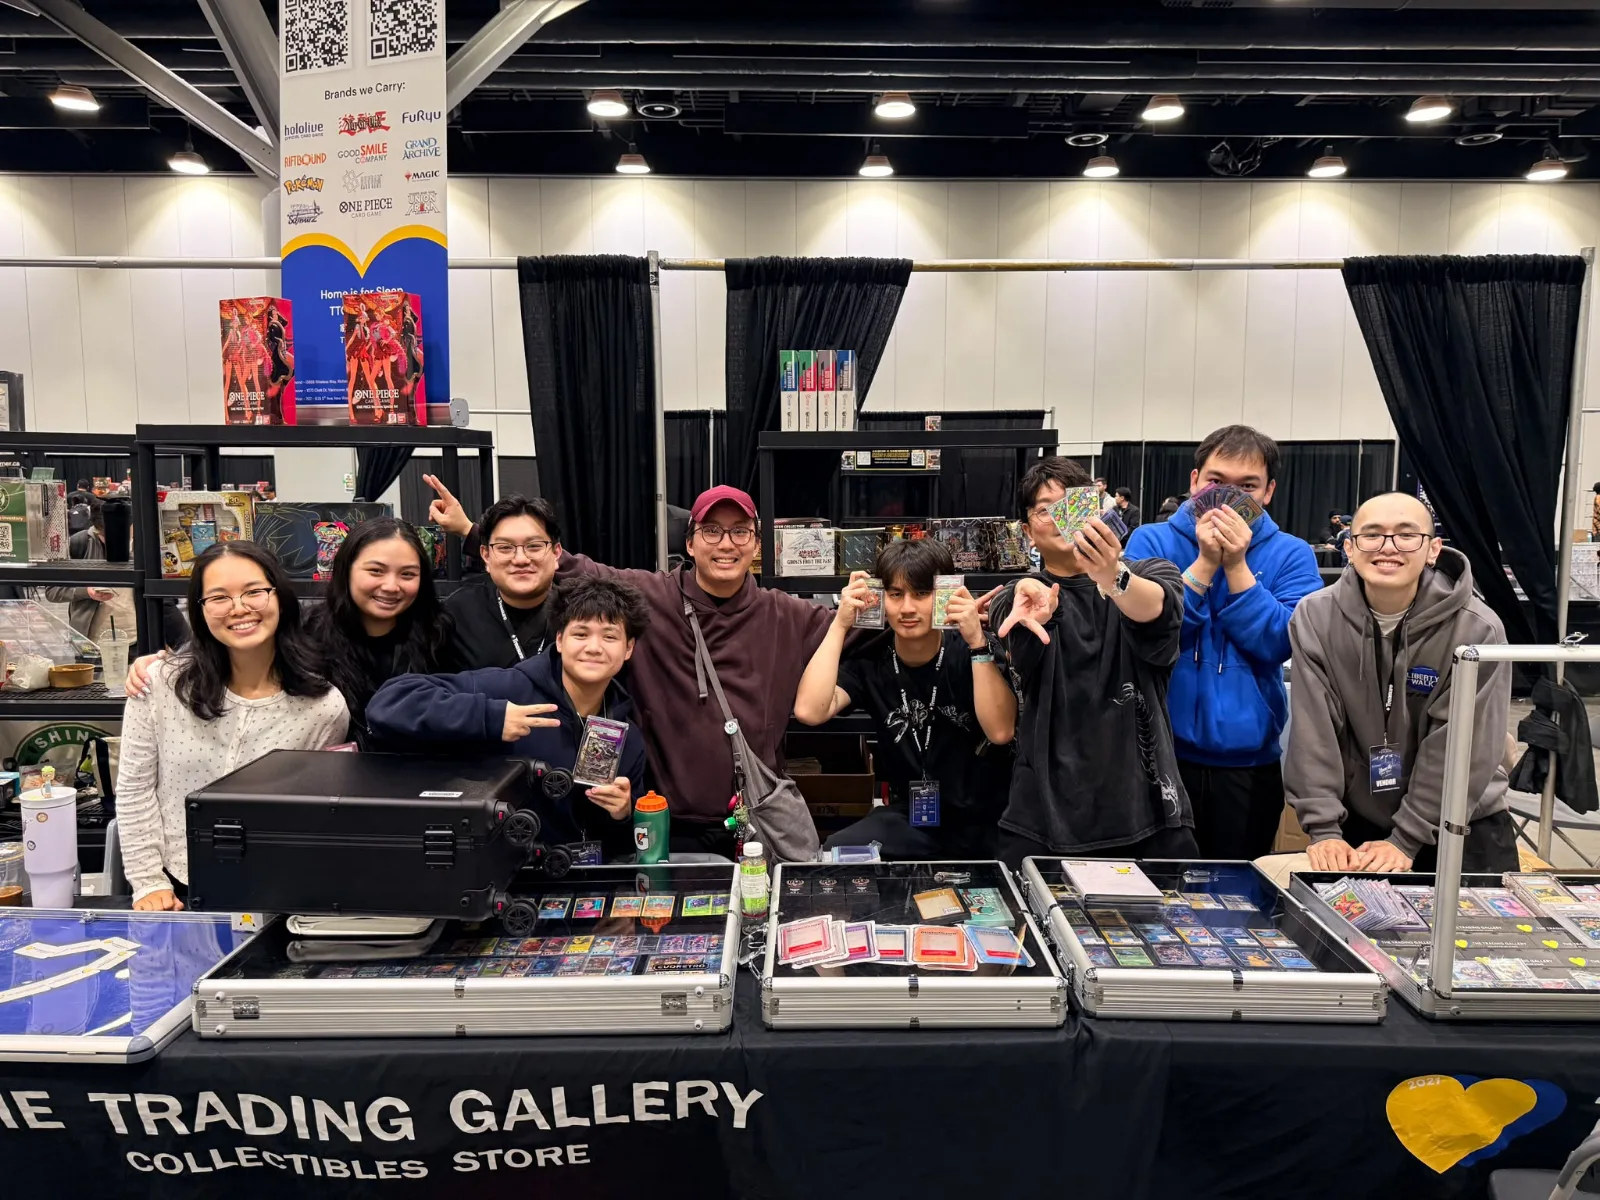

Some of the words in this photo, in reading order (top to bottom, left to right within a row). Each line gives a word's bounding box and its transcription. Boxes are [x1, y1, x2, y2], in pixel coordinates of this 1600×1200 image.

[325, 87, 357, 100] Brands
[360, 86, 373, 95] we
[375, 81, 406, 95] Carry:
[284, 122, 324, 136] hololive
[405, 138, 437, 150] GRAND
[338, 150, 360, 159] GOOD
[361, 143, 388, 156] SMILE
[402, 147, 441, 160] ARCHIVE
[284, 153, 327, 168] RIFTBOUND
[355, 154, 388, 164] COMPANY
[411, 170, 440, 179] MAGIC
[364, 198, 393, 211] PIECE
[320, 289, 348, 300] Home
[229, 392, 246, 402] ONE
[247, 391, 265, 400] PIECE
[354, 389, 374, 400] ONE
[376, 389, 400, 399] PIECE
[1406, 672, 1440, 684] LIBERTY
[1411, 679, 1434, 688] WALK
[1407, 1077, 1441, 1090] 2021
[88, 1090, 415, 1142] TRADING
[449, 1080, 764, 1134] GALLERY
[126, 1146, 429, 1179] COLLECTIBLES
[453, 1144, 590, 1172] STORE
